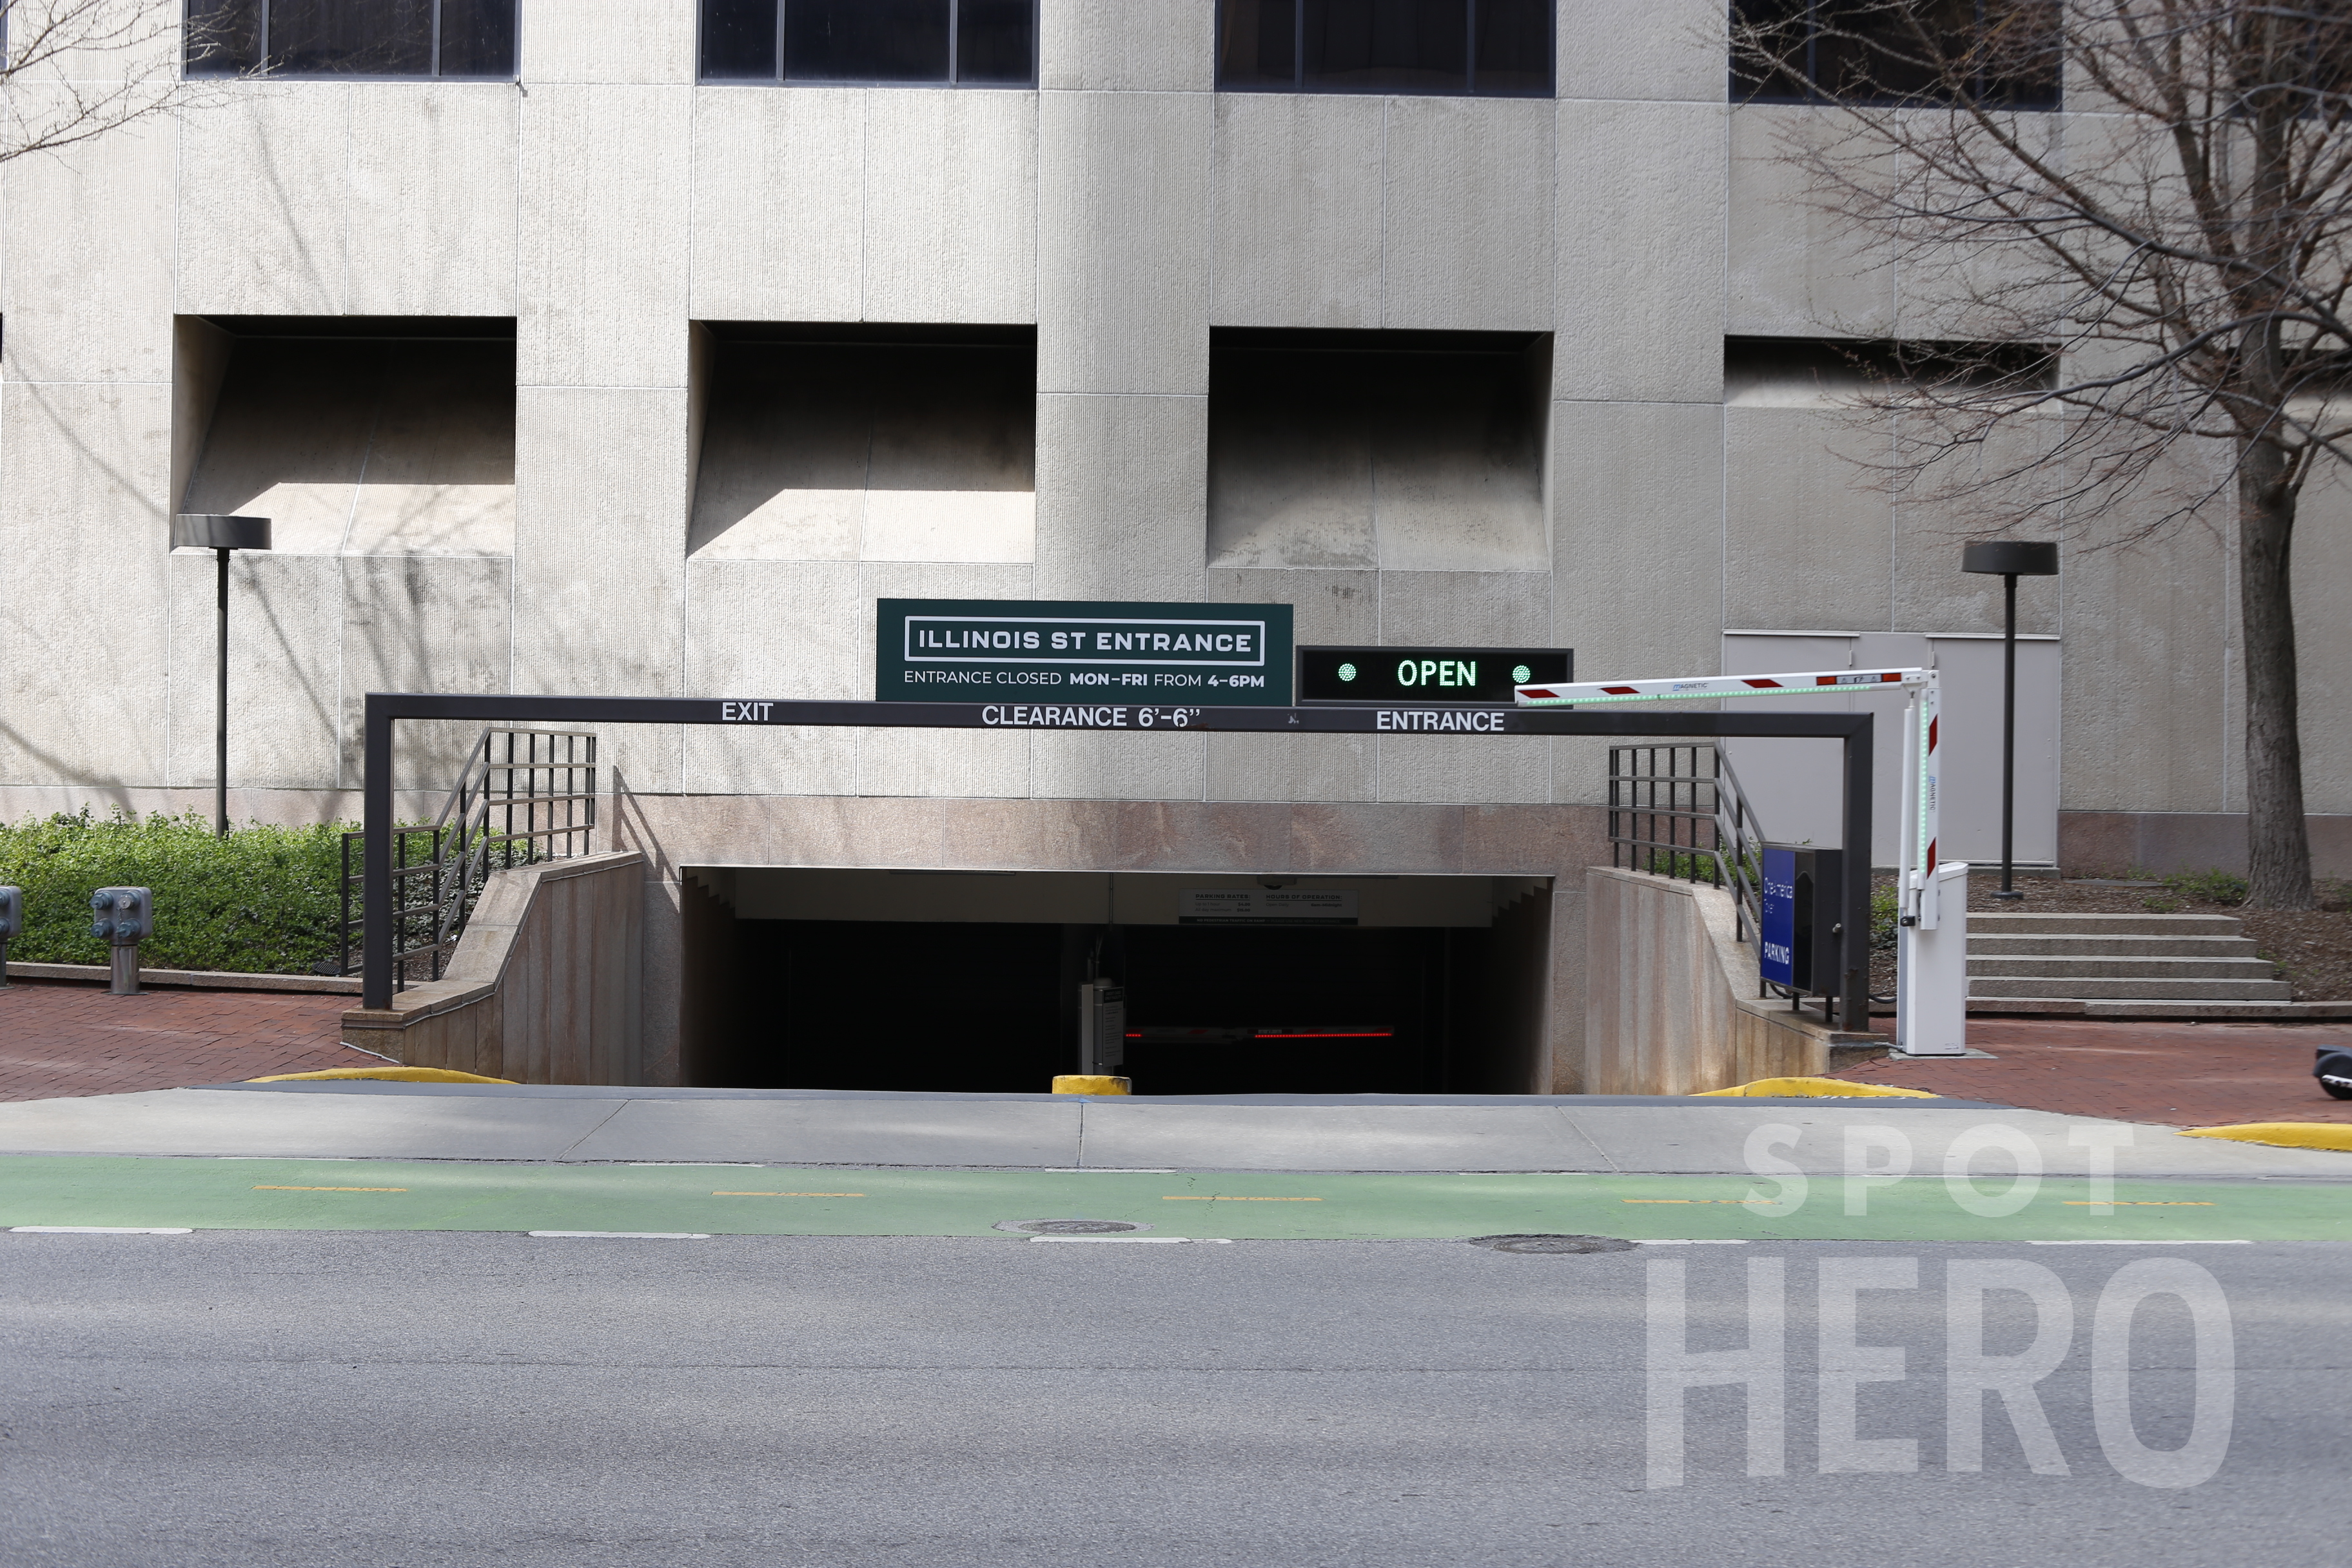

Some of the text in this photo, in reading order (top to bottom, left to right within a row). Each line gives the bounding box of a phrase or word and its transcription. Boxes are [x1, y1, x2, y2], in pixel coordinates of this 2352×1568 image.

[919, 630, 1251, 652] ILLINOIS ST ENTRANCE
[904, 670, 1264, 687] ENTRANCE CLOSED MON-FRI FROM 4-6PM
[1397, 660, 1476, 687] OPEN
[722, 701, 774, 721] EXIT
[982, 705, 1127, 727] CLEARANCE
[1377, 711, 1505, 731] ENTRANCE
[1764, 941, 1790, 965] PARKING
